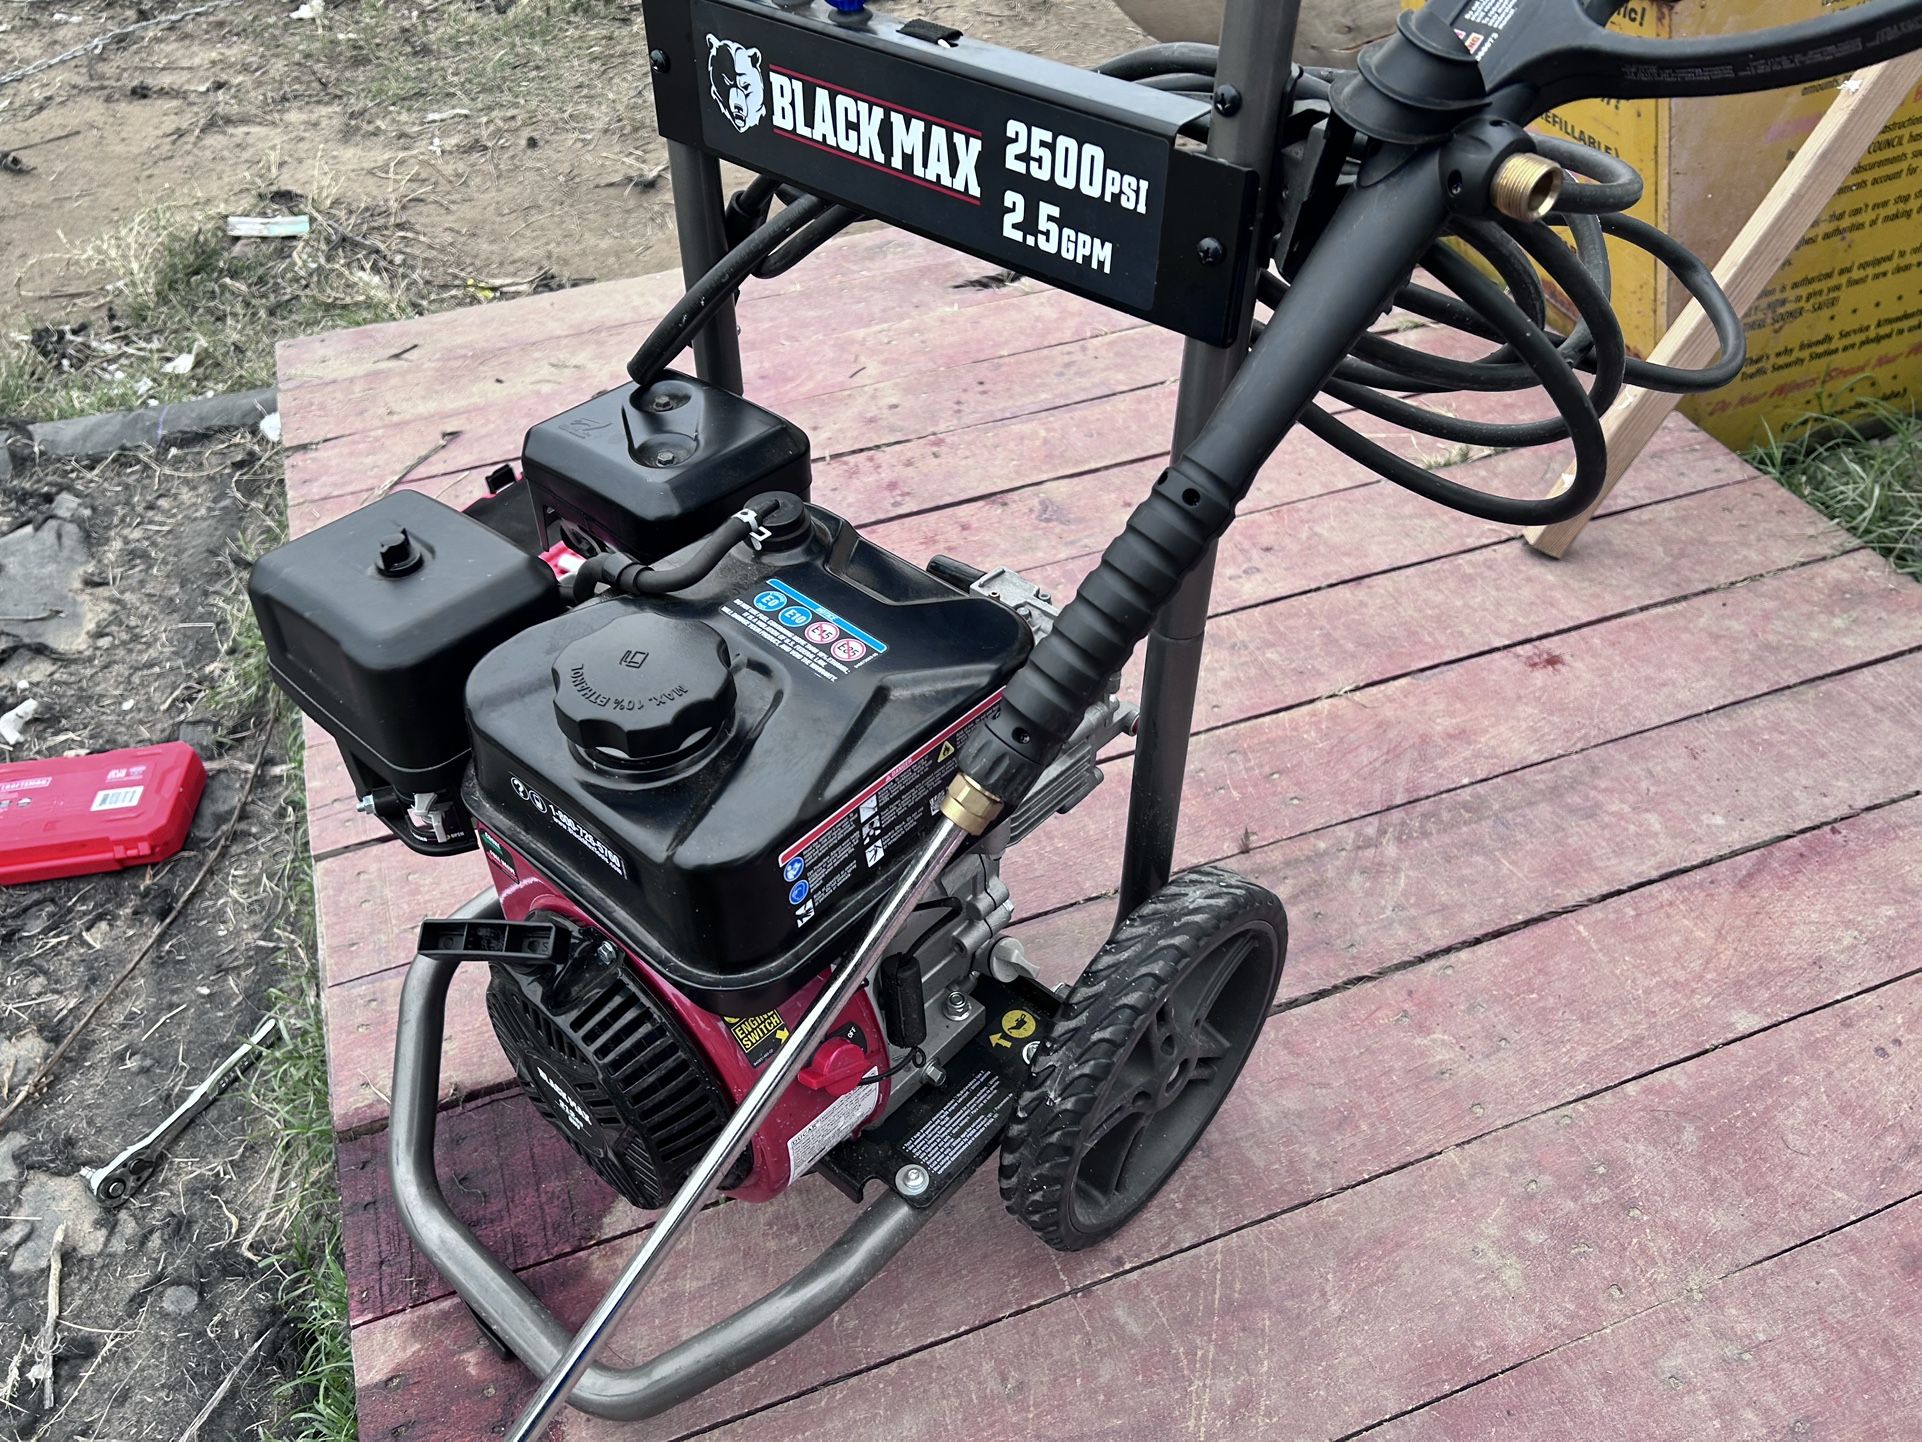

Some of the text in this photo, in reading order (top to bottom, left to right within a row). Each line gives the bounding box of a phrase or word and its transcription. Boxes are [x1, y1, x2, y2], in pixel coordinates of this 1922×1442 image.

[770, 71, 982, 198] BLACK MAX
[1868, 134, 1904, 154] COUNCIL
[1906, 163, 1919, 177] for
[1882, 208, 1913, 223] making
[760, 595, 779, 607] E0
[784, 609, 806, 623] E10
[811, 625, 833, 640] E15
[571, 663, 611, 707] ETHANOL
[649, 685, 689, 706] MAX.
[742, 1015, 780, 1049] SWITCH
[847, 1027, 858, 1039] OFF
[537, 1066, 569, 1104] BLACK
